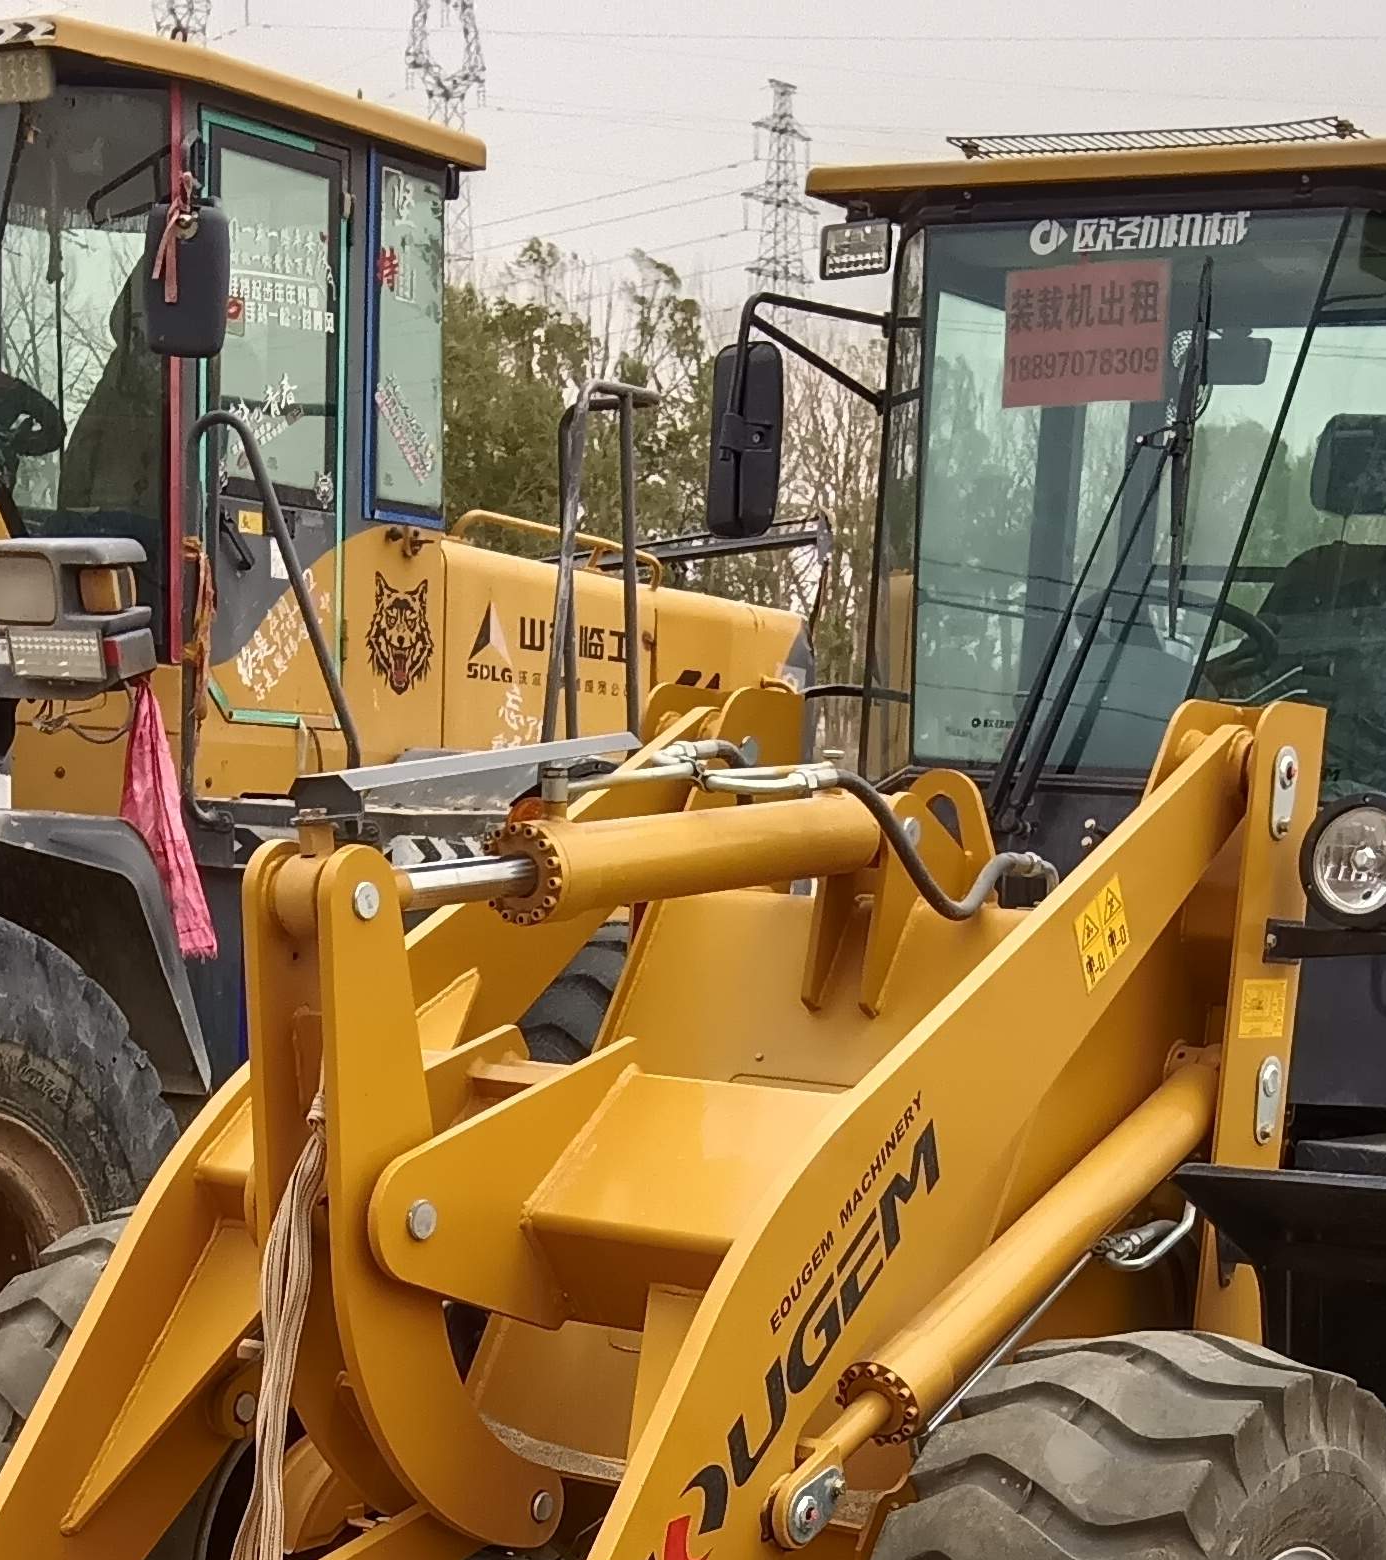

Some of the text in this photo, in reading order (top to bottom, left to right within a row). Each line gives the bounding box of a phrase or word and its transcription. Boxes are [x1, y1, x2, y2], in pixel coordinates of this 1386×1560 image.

[1073, 211, 1250, 252] 欧劲机械
[1010, 280, 1160, 332] 装载机出租
[1009, 347, 1160, 383] 18897078309
[466, 662, 513, 684] SDLG
[769, 1089, 922, 1335] EOUGEM MACHINERY
